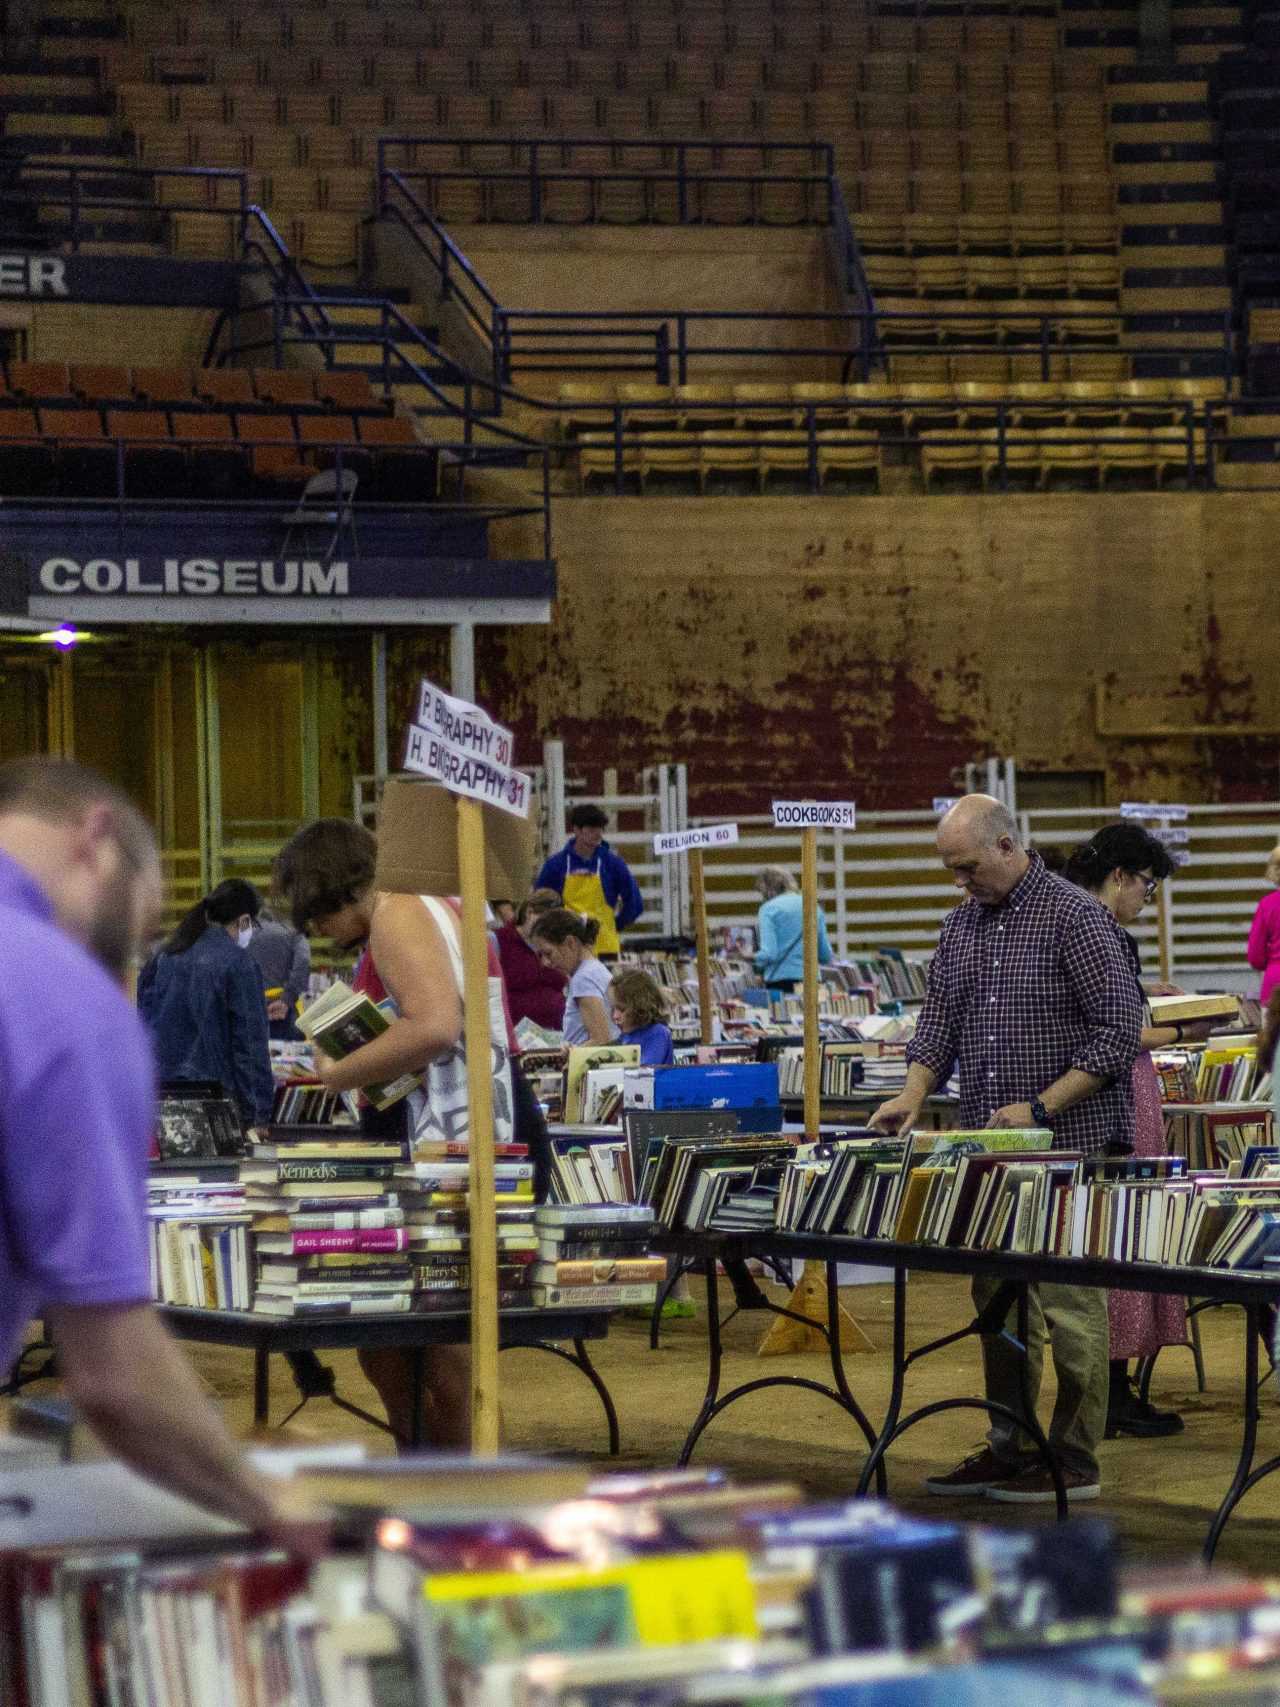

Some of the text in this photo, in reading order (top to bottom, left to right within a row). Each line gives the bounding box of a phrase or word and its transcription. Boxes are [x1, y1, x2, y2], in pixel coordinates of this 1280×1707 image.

[39, 558, 349, 594] COLISEUM
[496, 736, 509, 766] 30
[507, 777, 525, 808] 31
[843, 808, 853, 825] 51
[716, 830, 729, 841] 60
[280, 1161, 337, 1182] Kennedys
[296, 1239, 317, 1247] GAIL
